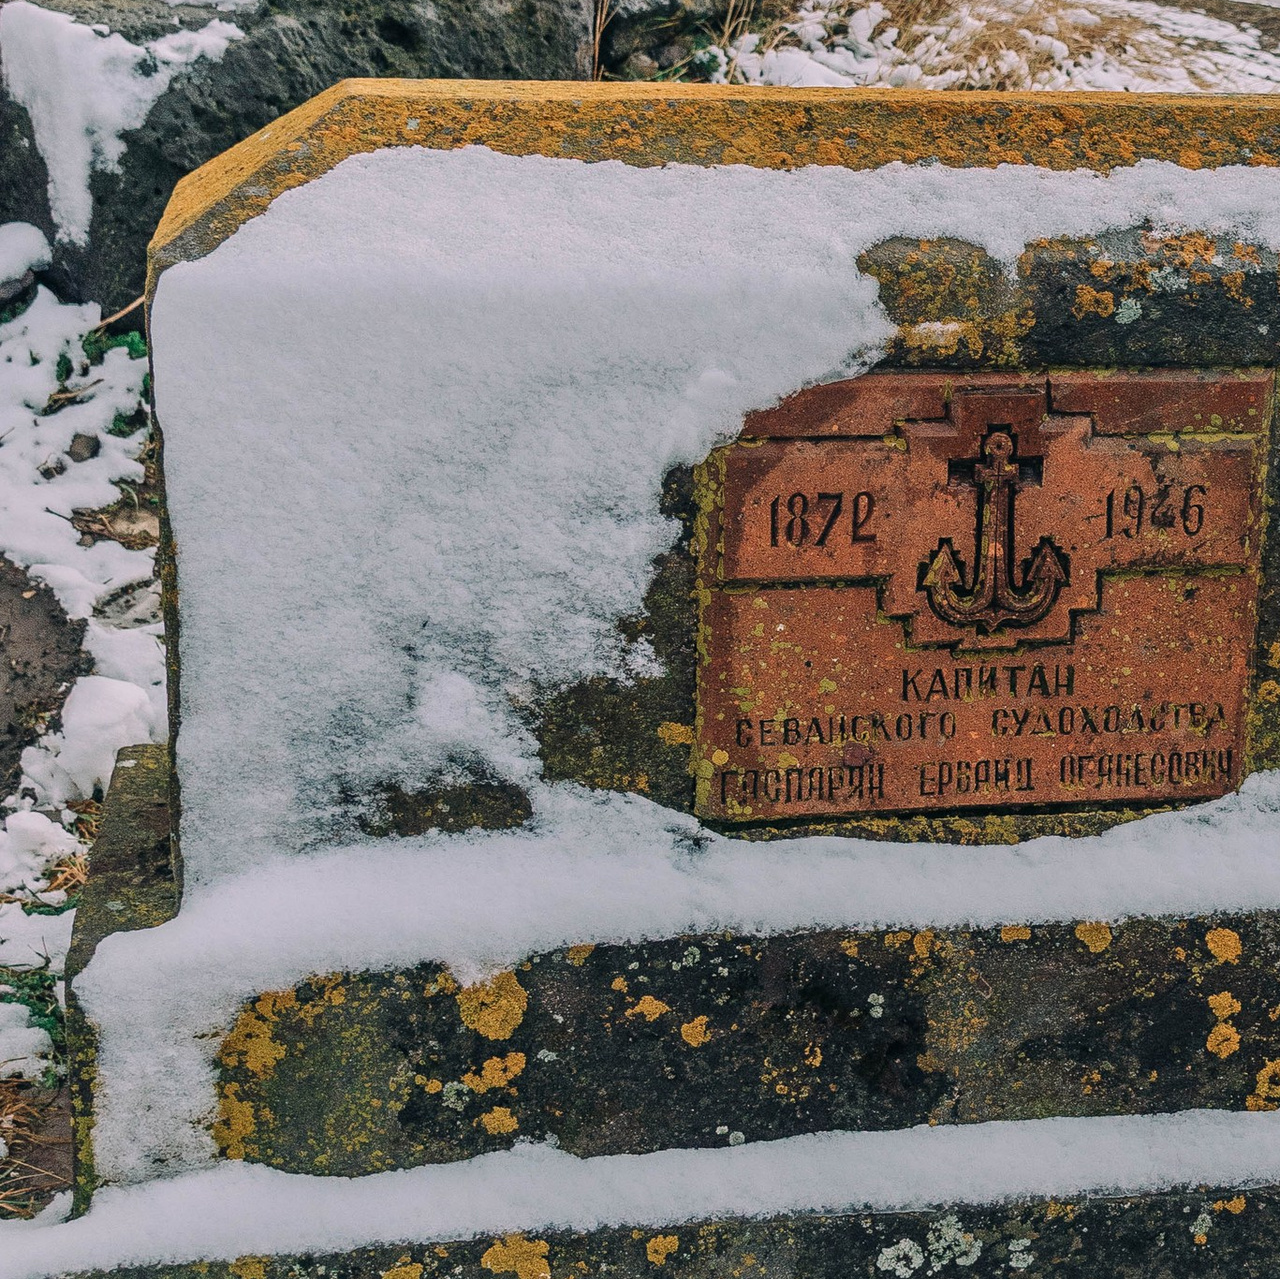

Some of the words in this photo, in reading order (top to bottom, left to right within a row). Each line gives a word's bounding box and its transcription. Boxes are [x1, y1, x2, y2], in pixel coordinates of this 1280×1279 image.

[769, 490, 878, 548] 1872
[901, 664, 1077, 704] КАПИТАН
[734, 710, 958, 749] СЕВАНСКОГО
[990, 702, 1228, 738] СУДОХОДСТВА
[719, 764, 886, 805] ГАСПАРЯН
[919, 756, 1036, 798] ЕРВАНД
[1059, 748, 1234, 792] ОГАНЕСОВИЧ
